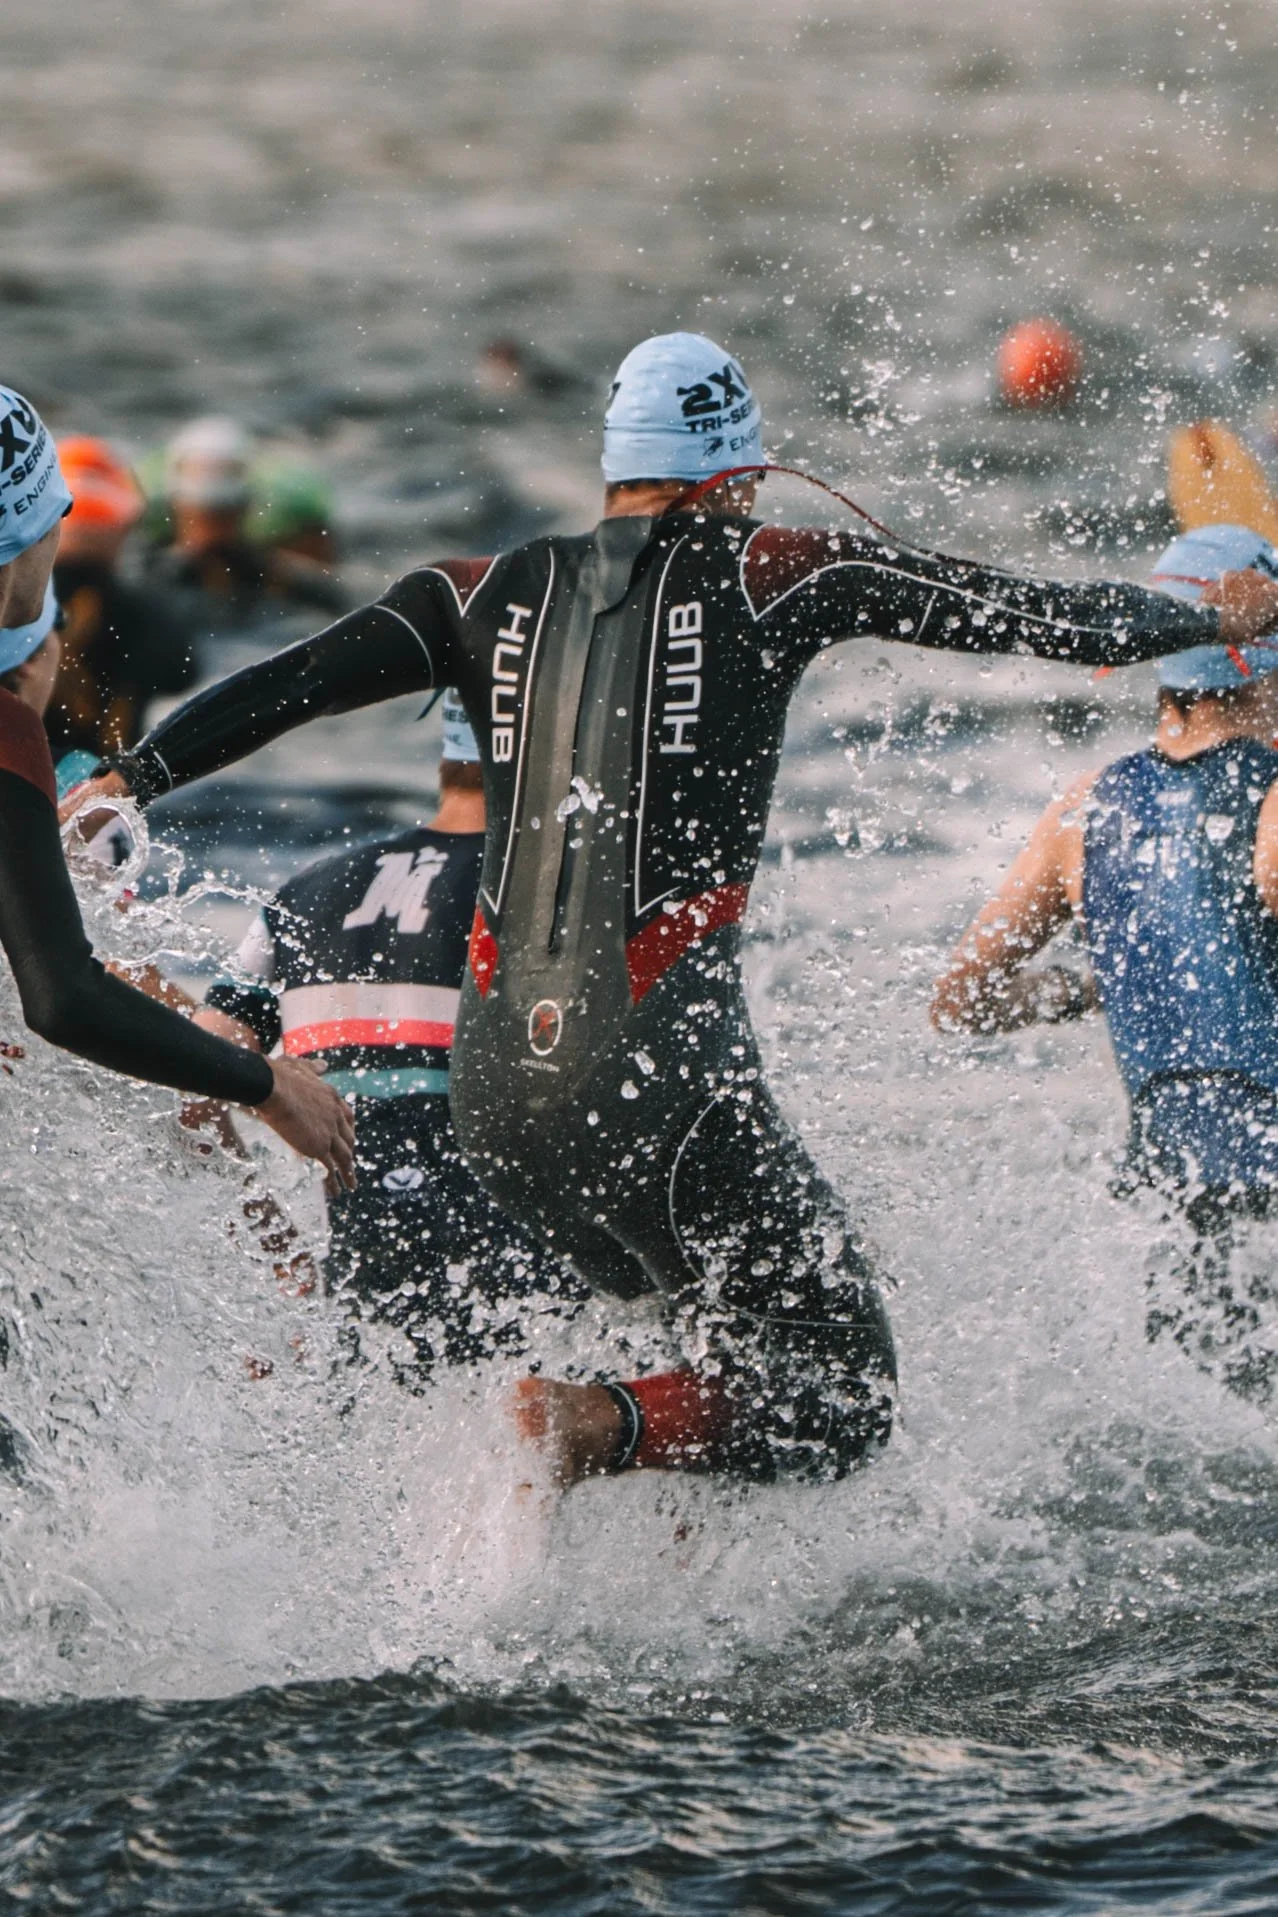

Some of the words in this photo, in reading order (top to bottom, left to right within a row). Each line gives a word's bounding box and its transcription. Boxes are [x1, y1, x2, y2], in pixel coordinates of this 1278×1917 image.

[677, 362, 749, 417] 2X
[491, 602, 533, 764] HUUB
[659, 600, 703, 754] HUUB
